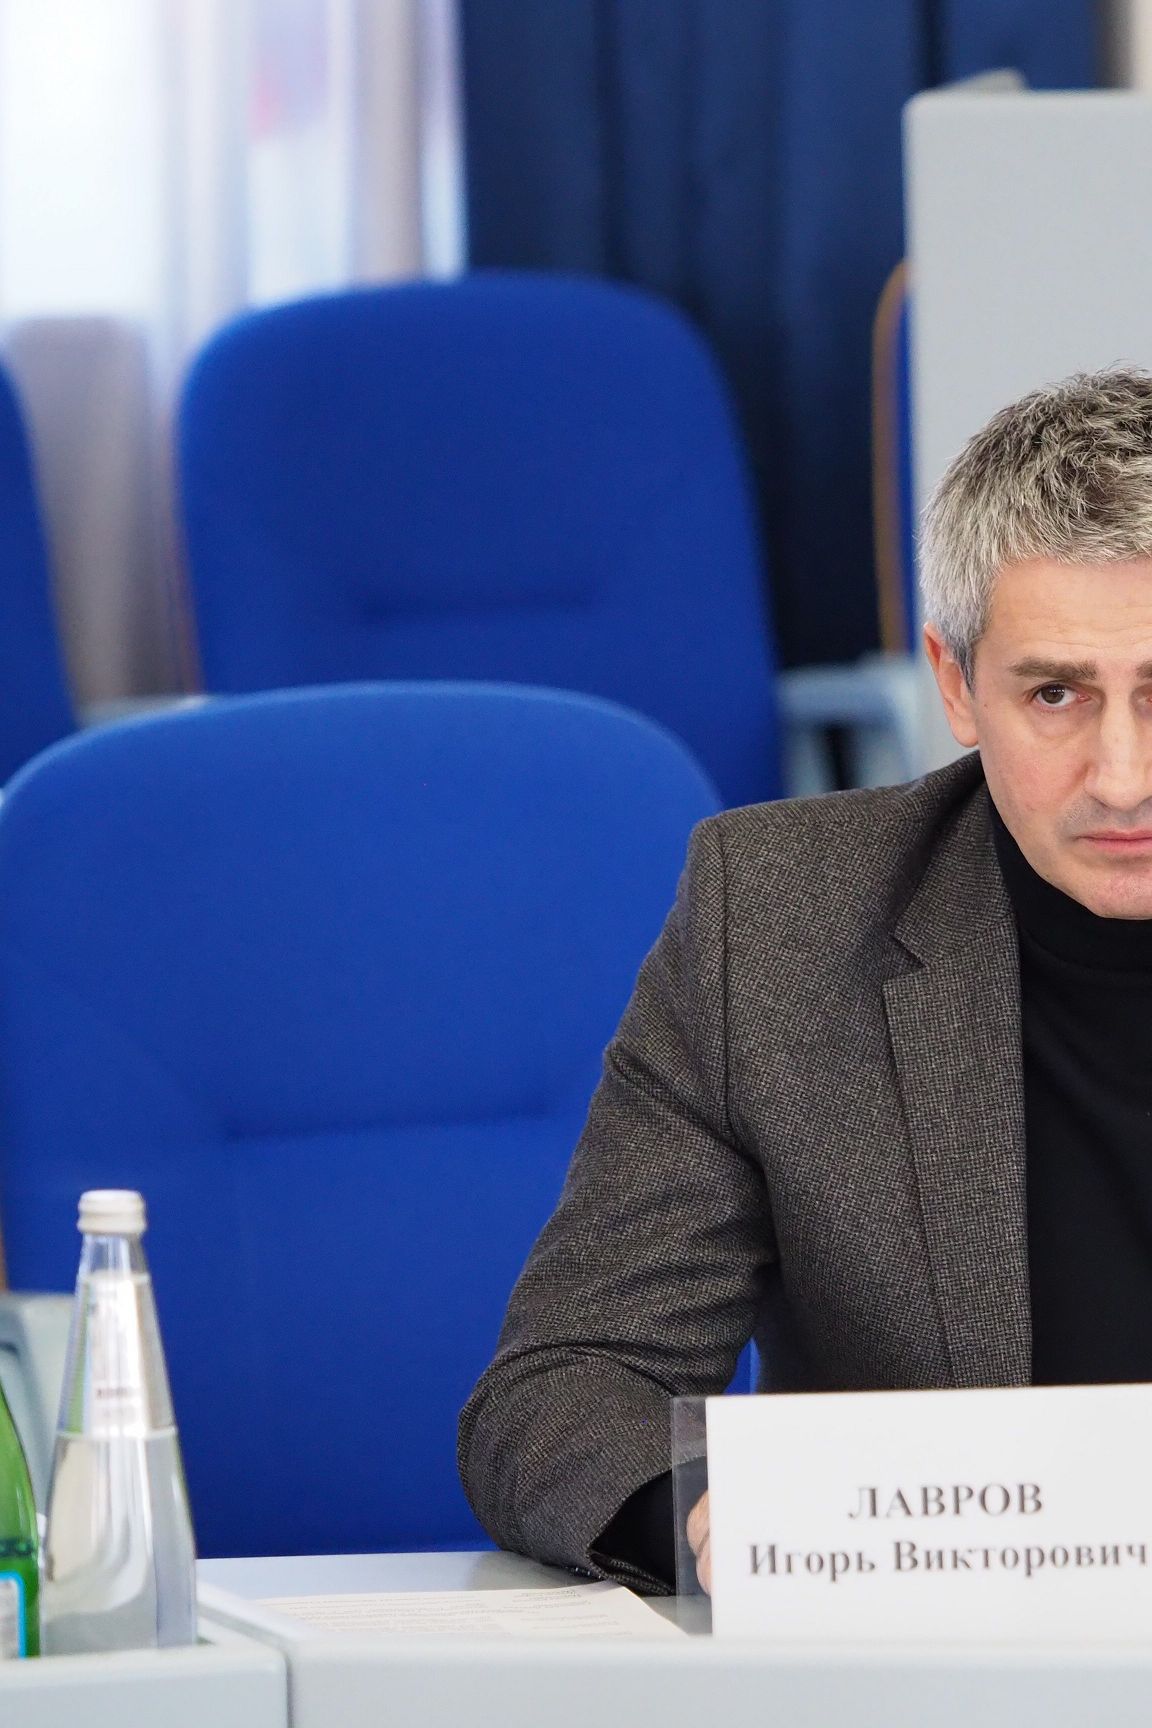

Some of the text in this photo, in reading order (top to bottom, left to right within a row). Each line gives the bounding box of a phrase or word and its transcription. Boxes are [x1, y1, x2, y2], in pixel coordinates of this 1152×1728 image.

[847, 1483, 1045, 1520] ЛАВРОВ
[749, 1540, 1148, 1582] Игорь Викторович
